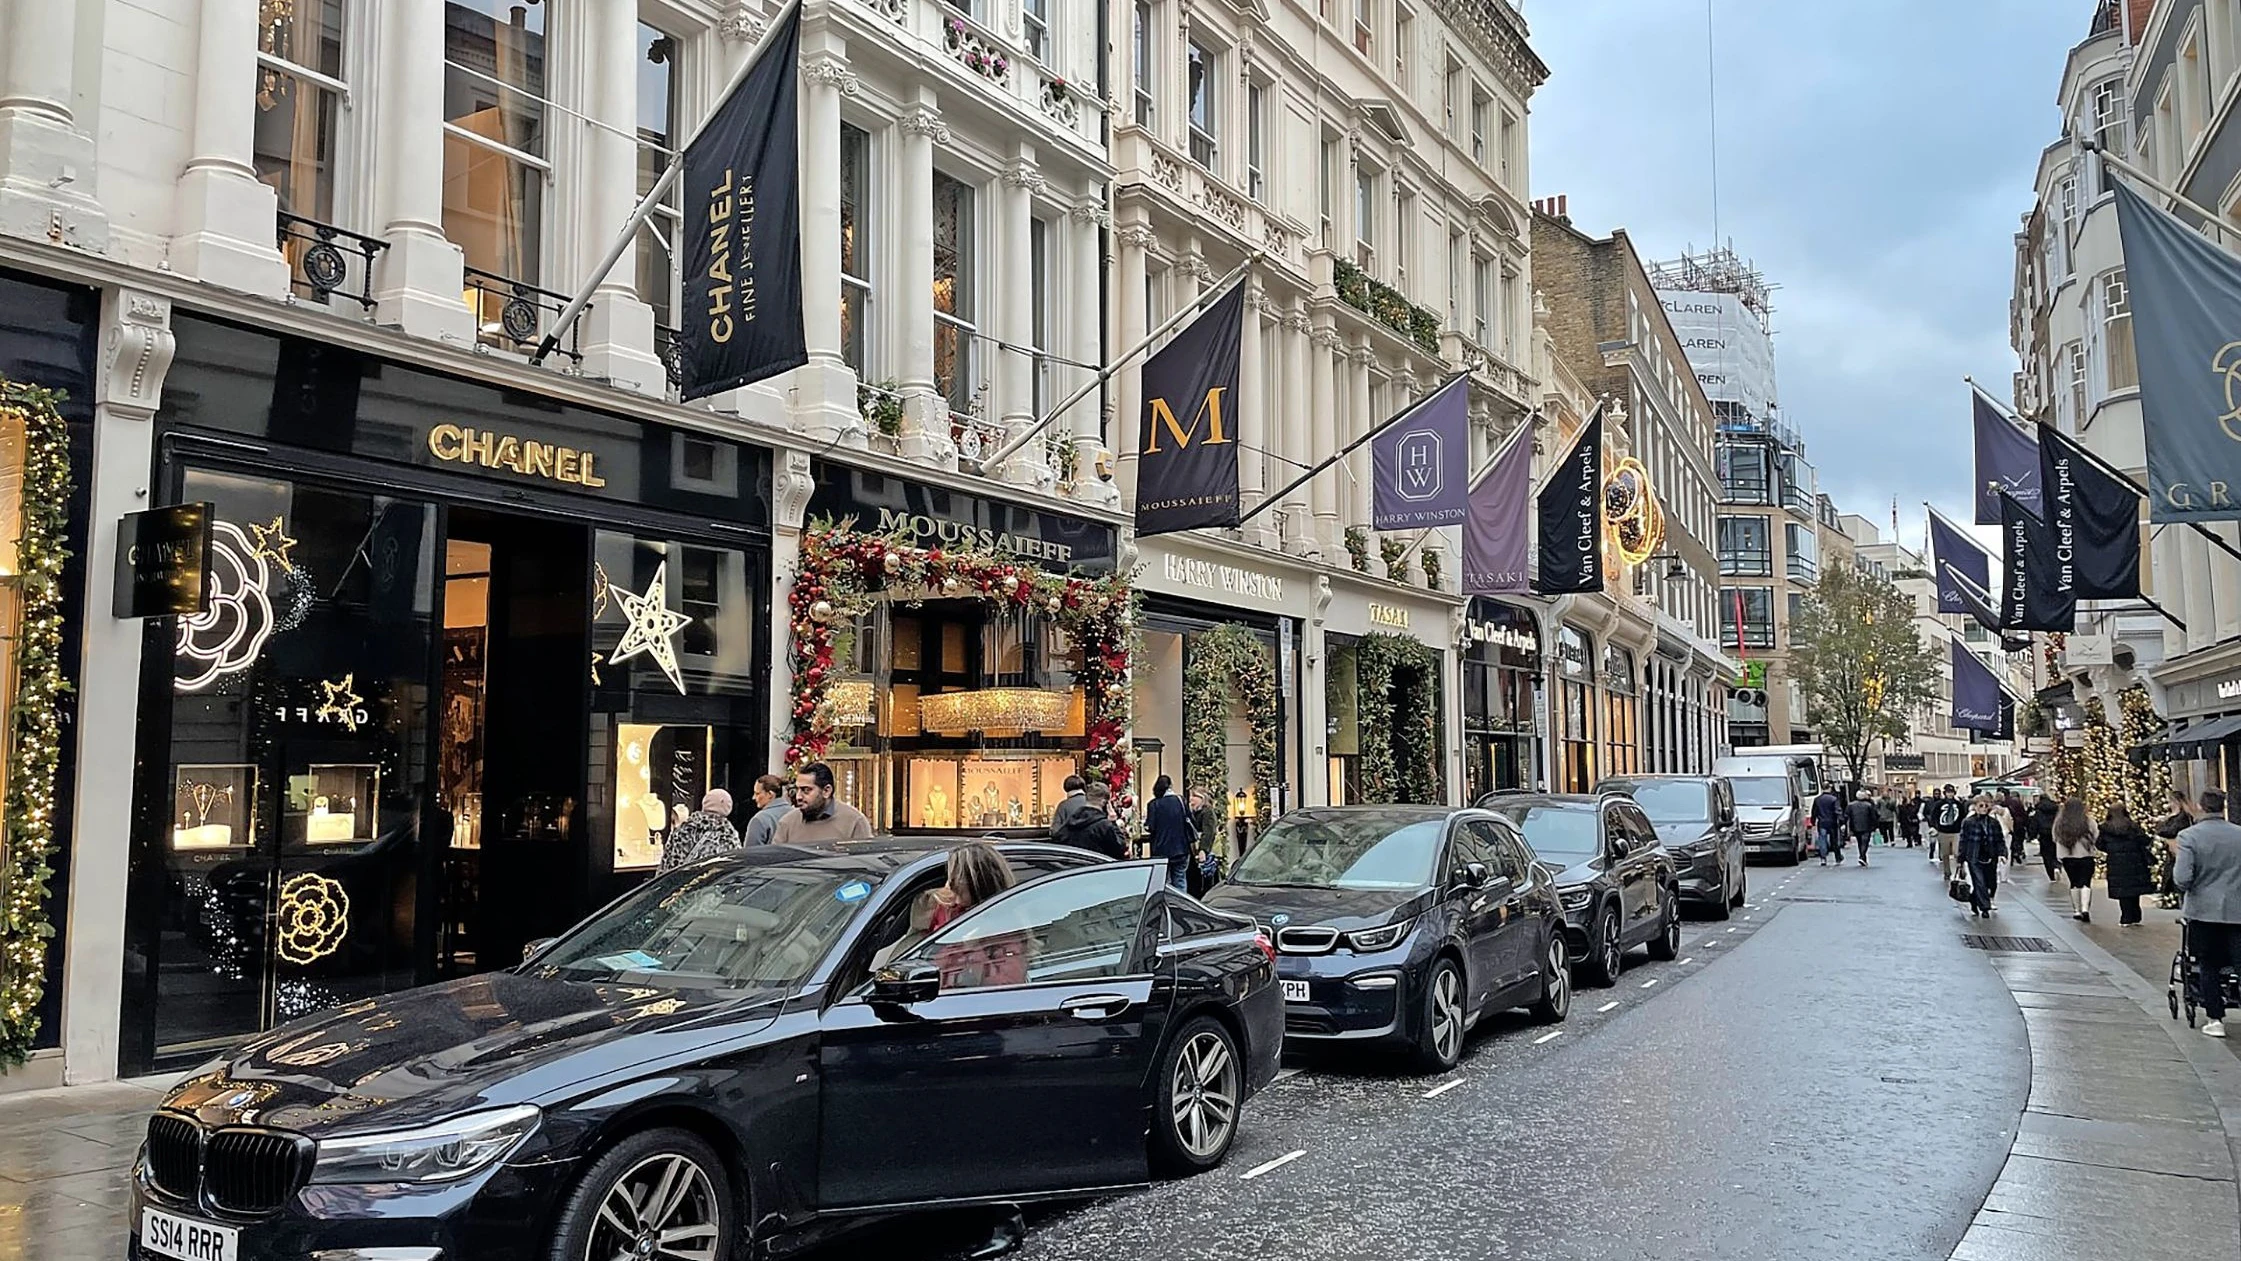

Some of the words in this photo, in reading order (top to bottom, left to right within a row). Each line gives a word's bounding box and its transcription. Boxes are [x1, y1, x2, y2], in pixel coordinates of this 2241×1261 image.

[709, 169, 734, 343] CHANEL
[740, 278, 756, 322] FINE
[1143, 386, 1232, 455] M
[427, 422, 606, 488] CHANEL
[1411, 445, 1427, 467] H
[1578, 445, 1595, 492] Arpels
[1406, 466, 1432, 488] W
[2054, 458, 2075, 505] Arpels
[1140, 494, 1233, 512] MOUSSAIEFF
[1375, 512, 1412, 525] HARRY
[1414, 508, 1466, 522] WINSTON
[1580, 495, 1592, 507] &
[2060, 507, 2072, 519] &
[878, 507, 1072, 563] MOUSSAIEFF
[1577, 510, 1592, 551] Cleef
[2011, 519, 2028, 558] Arpels
[2056, 520, 2073, 562] Cleef
[1164, 553, 1217, 589] HARRY
[1219, 565, 1283, 602] WINSTON
[1466, 572, 1524, 584] TASAKI
[1578, 554, 1594, 585] Van
[2016, 558, 2025, 568] &
[2057, 565, 2073, 592] Van
[2011, 569, 2026, 600] Cleef
[2010, 603, 2025, 625] Van
[1468, 617, 1485, 642] Van
[1484, 620, 1507, 646] Cleef
[1506, 632, 1514, 647] &
[1513, 631, 1537, 656] Arpels
[1955, 708, 1996, 722] Chopard
[150, 1215, 184, 1253] SS14
[188, 1225, 224, 1261] RRR
